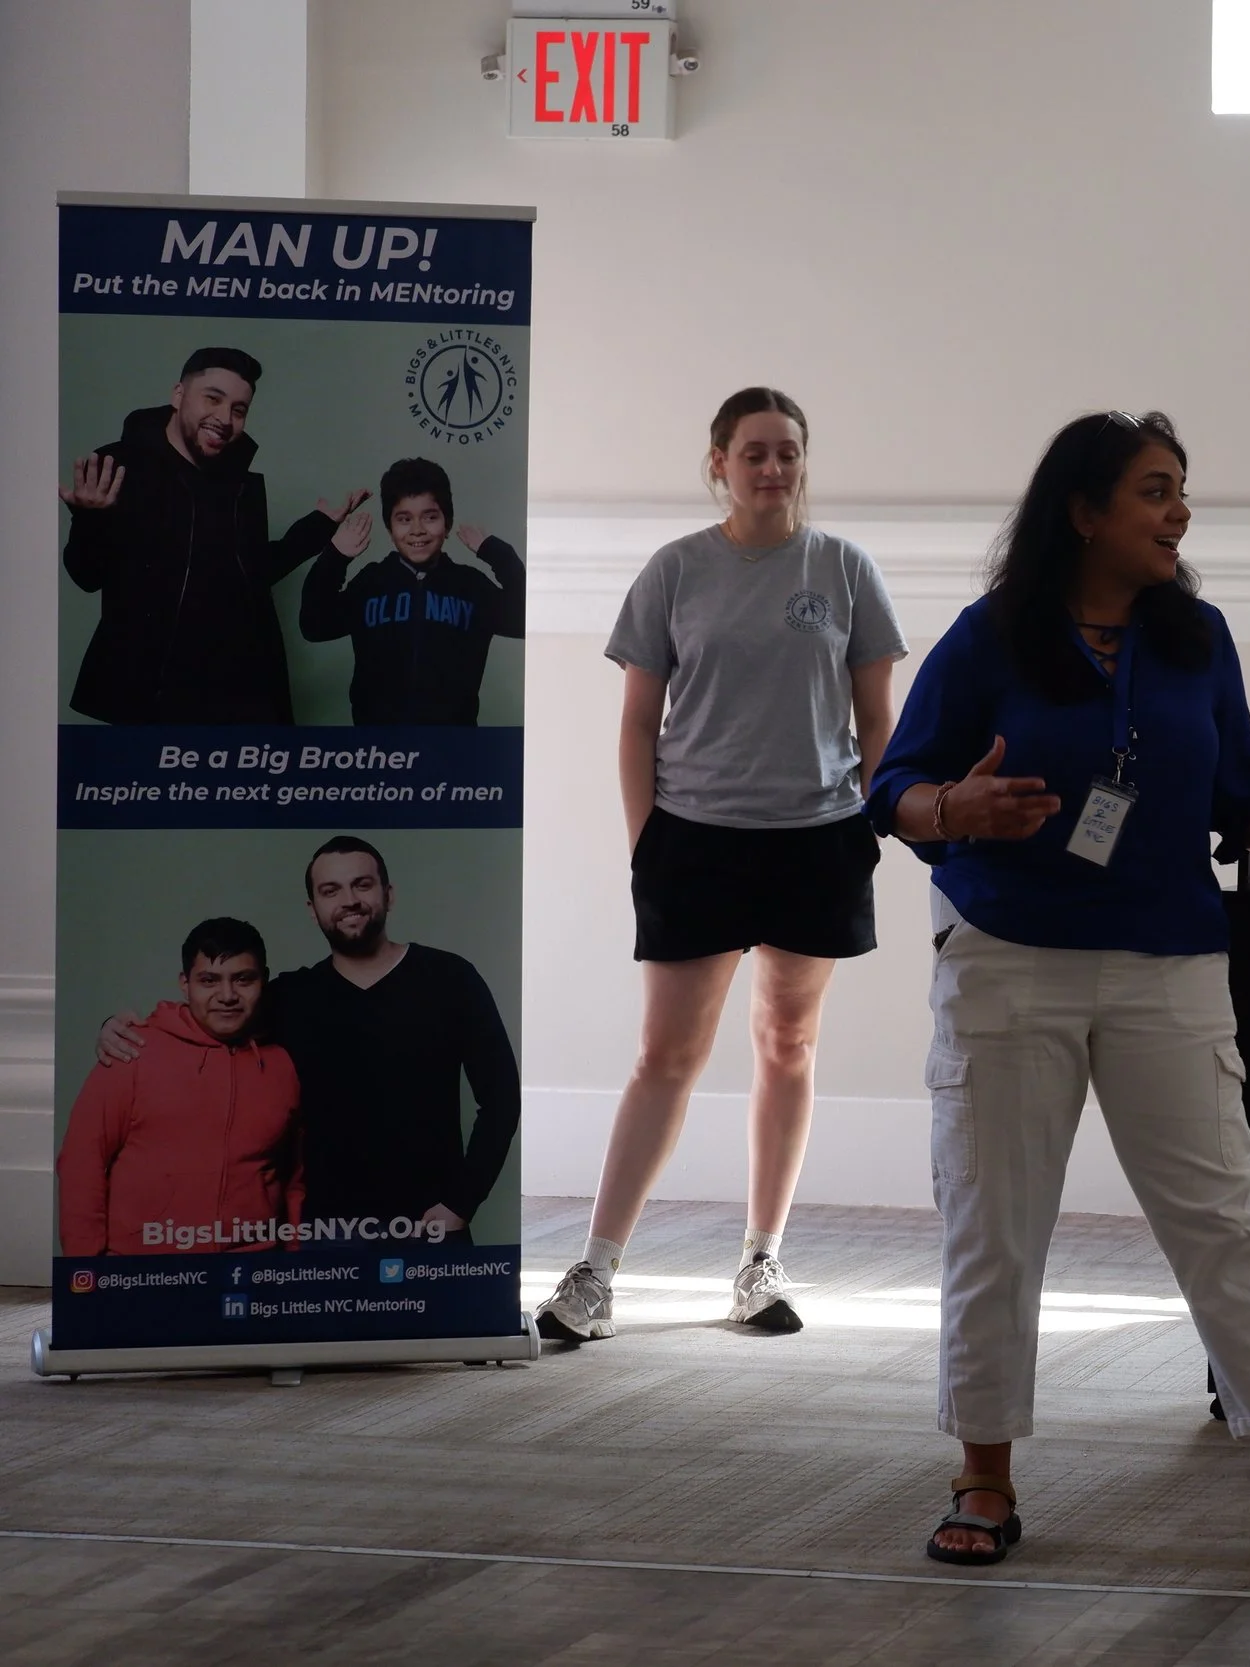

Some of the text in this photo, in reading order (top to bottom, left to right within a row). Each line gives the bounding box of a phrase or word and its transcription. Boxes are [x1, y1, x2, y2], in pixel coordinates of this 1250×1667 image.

[534, 31, 650, 123] EXIT
[611, 124, 630, 137] 58
[160, 219, 438, 272] MAN UP!
[73, 273, 515, 311] Put the MEN back in MENtoring
[405, 348, 427, 385] BIGS
[426, 338, 438, 349] &
[408, 403, 513, 445] MENTORING
[365, 590, 474, 631] OLD NAVY
[158, 744, 420, 775] Be a Big Brother
[75, 781, 504, 806] Inspire the next generation of men
[142, 1216, 446, 1250] BigsLittlesNYC.Org
[97, 1271, 208, 1289] @BigsLittlesNYC
[251, 1266, 360, 1285] @BigsLittlesNYC
[404, 1262, 511, 1281] @BigsLittlesNYC
[250, 1302, 279, 1318] Bigs
[281, 1300, 321, 1315] Littles
[325, 1300, 353, 1313] NYC
[356, 1297, 426, 1316] Mentoring
